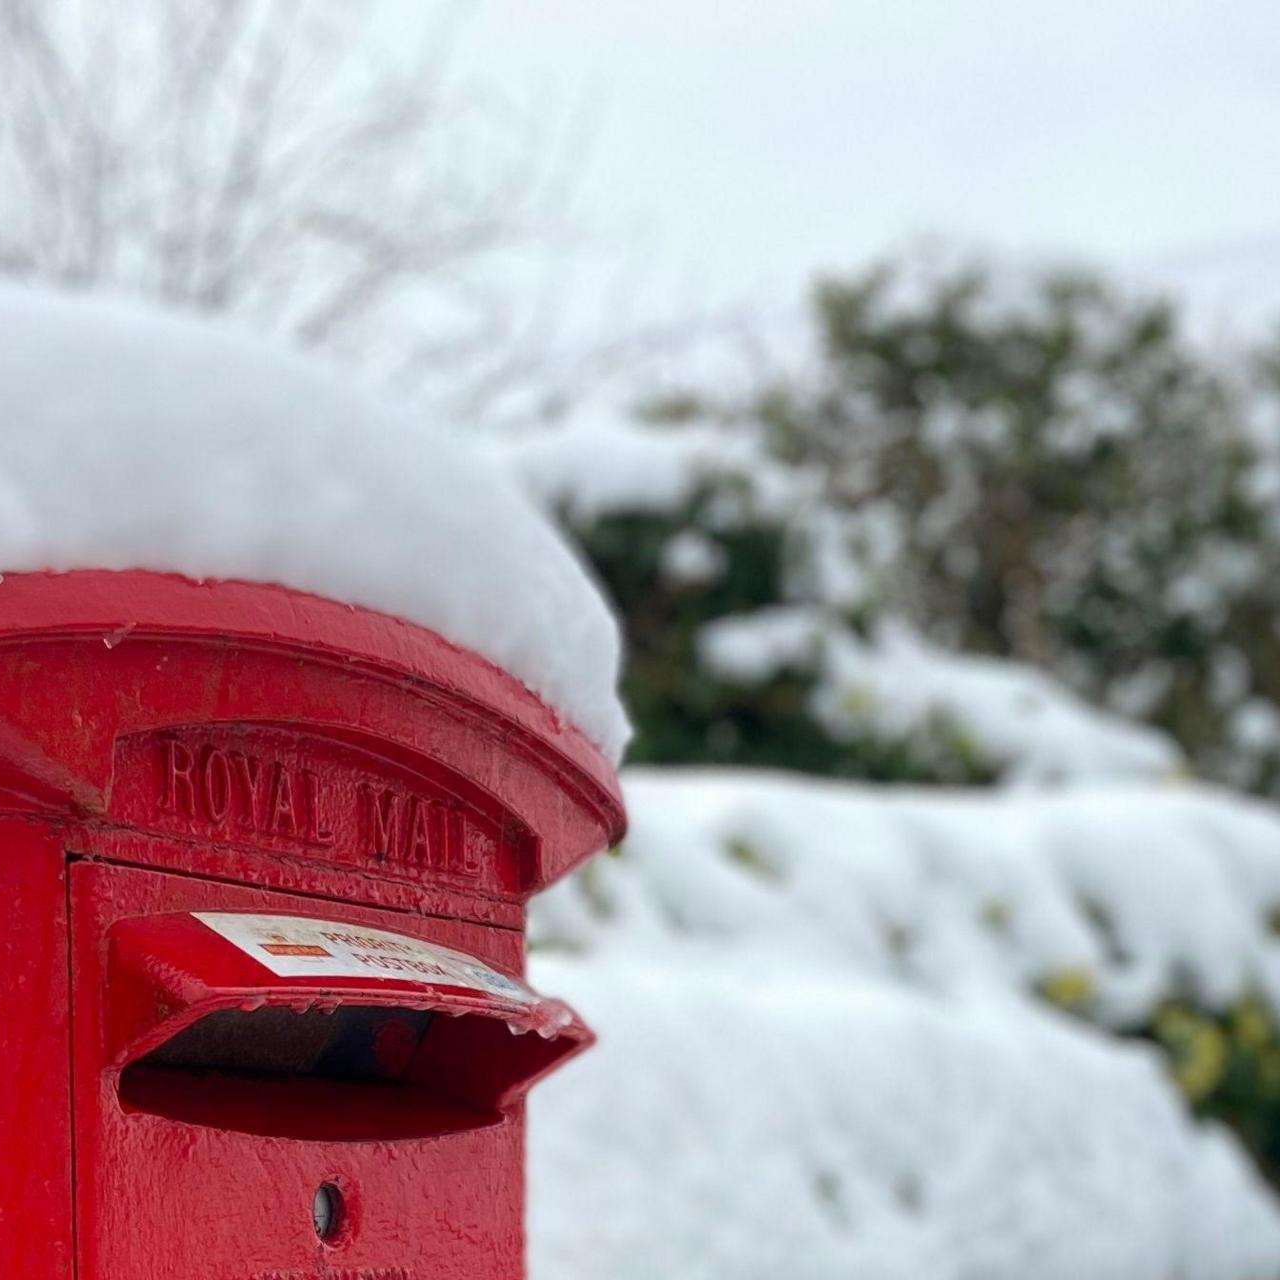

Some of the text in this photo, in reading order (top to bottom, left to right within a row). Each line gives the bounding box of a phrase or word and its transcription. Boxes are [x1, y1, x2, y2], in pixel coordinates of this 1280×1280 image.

[161, 739, 480, 875] ROYAL MAIL
[321, 931, 411, 953] PRIORITY
[352, 952, 452, 977] POSTBOX
